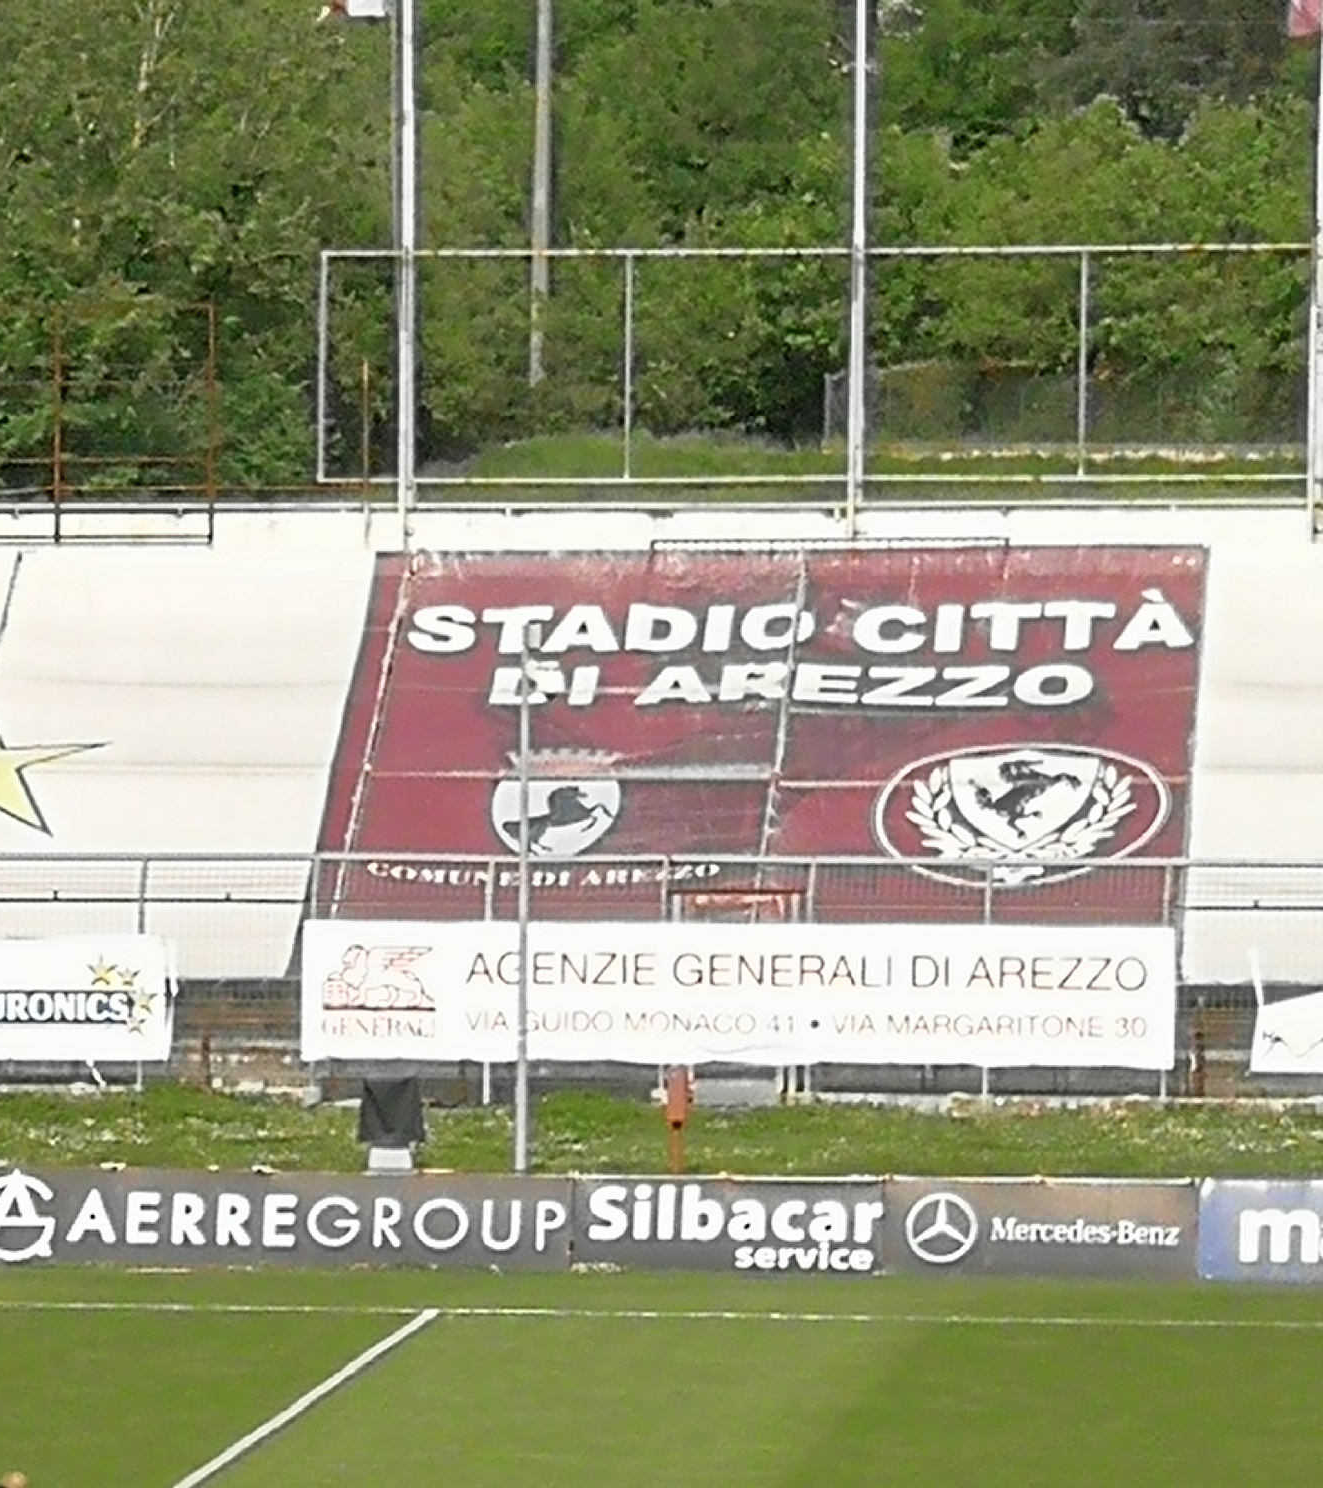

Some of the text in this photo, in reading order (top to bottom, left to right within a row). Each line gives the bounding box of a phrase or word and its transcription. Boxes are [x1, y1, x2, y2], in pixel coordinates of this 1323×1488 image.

[406, 588, 1196, 656] STADIO CITTÀ
[489, 664, 1096, 708] DI AREZZO
[673, 952, 892, 988] GENERALI
[912, 955, 950, 988] DI
[967, 957, 1148, 992] AREZZO
[322, 1020, 435, 1039] GENERALI
[465, 1011, 508, 1031] VIA
[624, 1012, 756, 1033] MONACO
[766, 1015, 795, 1033] 41
[832, 1014, 881, 1034] VIA
[891, 1014, 1102, 1037] MARGARITONE
[1114, 1016, 1147, 1036] 30
[66, 1189, 568, 1250] AERREGROUP
[588, 1184, 885, 1243] Silbacar
[990, 1216, 1181, 1246] Mercedes-Benz
[734, 1244, 874, 1272] service
